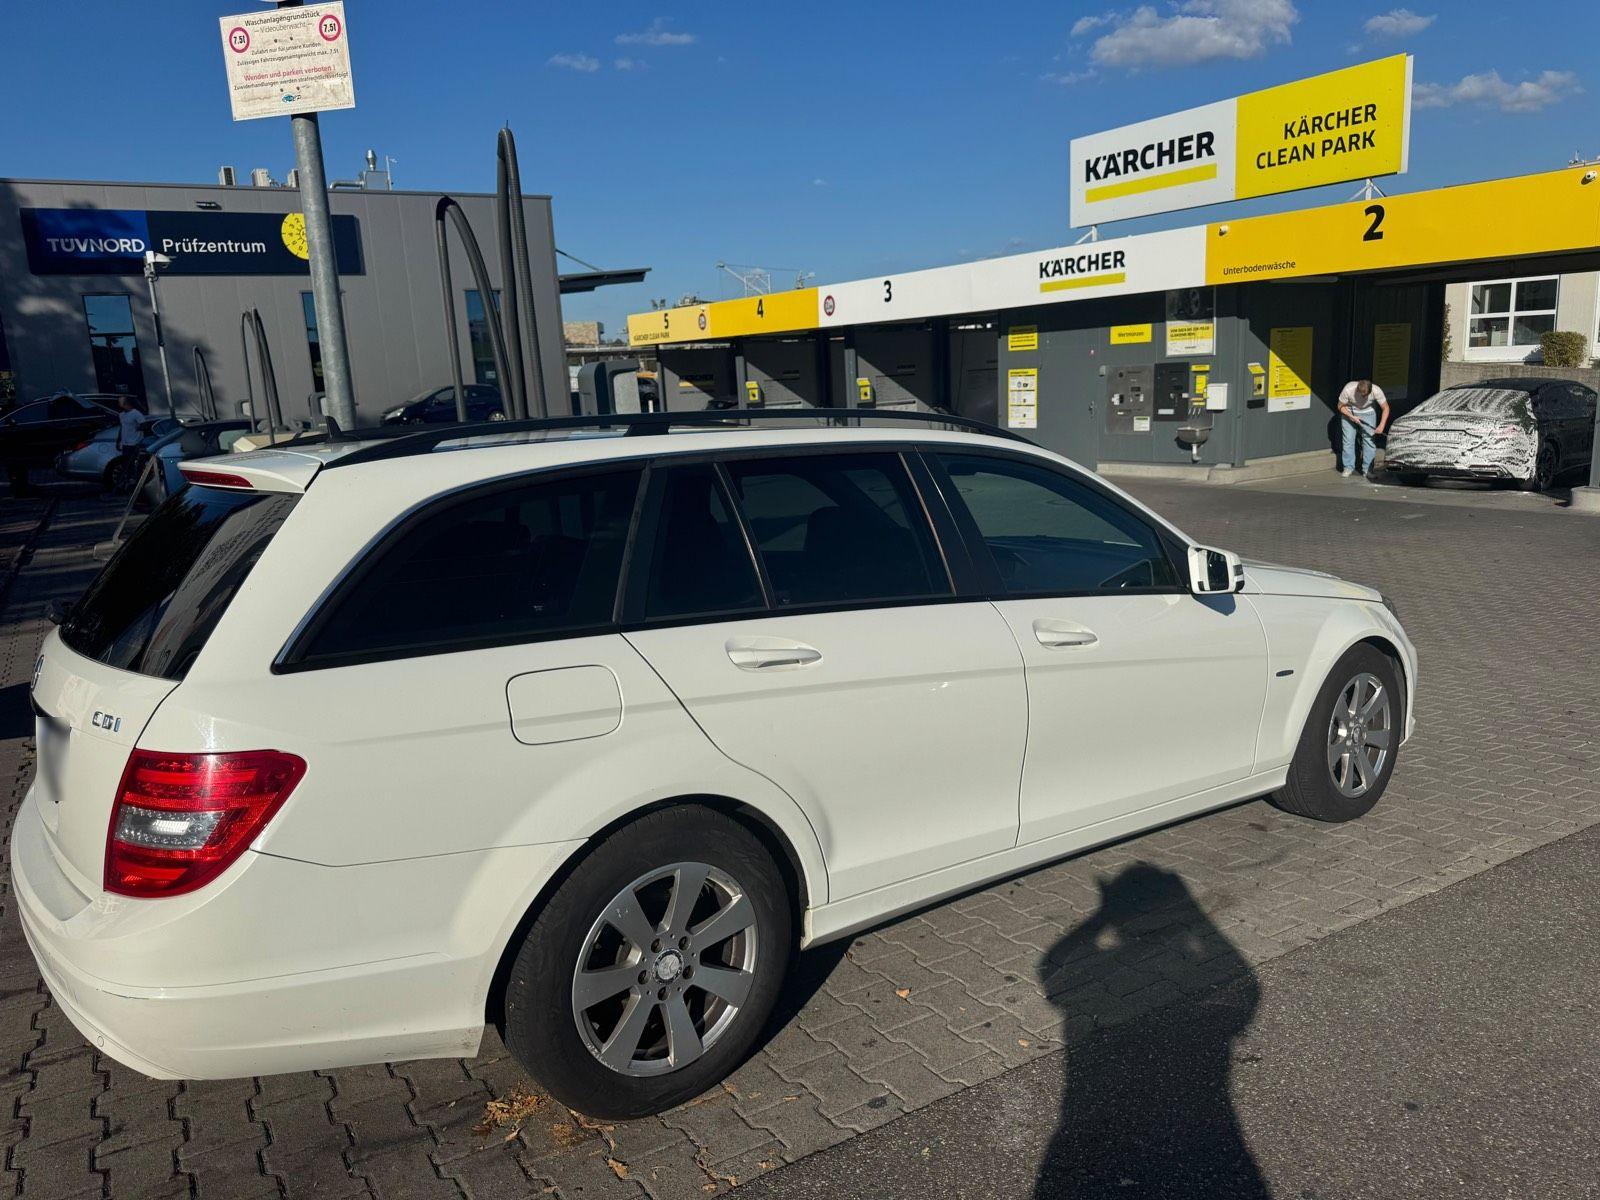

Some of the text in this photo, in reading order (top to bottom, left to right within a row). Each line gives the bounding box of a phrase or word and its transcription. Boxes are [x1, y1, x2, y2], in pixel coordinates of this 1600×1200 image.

[244, 10, 320, 27] Waschanlagengrundstück
[243, 73, 268, 82] Wenden
[269, 70, 282, 78] und
[282, 69, 304, 78] parken
[304, 65, 332, 74] verboten
[1284, 103, 1378, 140] KÄRCHER
[1085, 130, 1215, 183] KÄRCHER
[1256, 129, 1376, 171] CLEAN PARK
[1362, 204, 1386, 242] 2
[162, 238, 267, 254] Prüfzentrum
[1039, 249, 1126, 279] KÄRCHER
[1222, 260, 1297, 276] Unterbodenwäsche
[883, 280, 893, 303] 3
[756, 298, 764, 318] 4
[663, 312, 669, 329] 5
